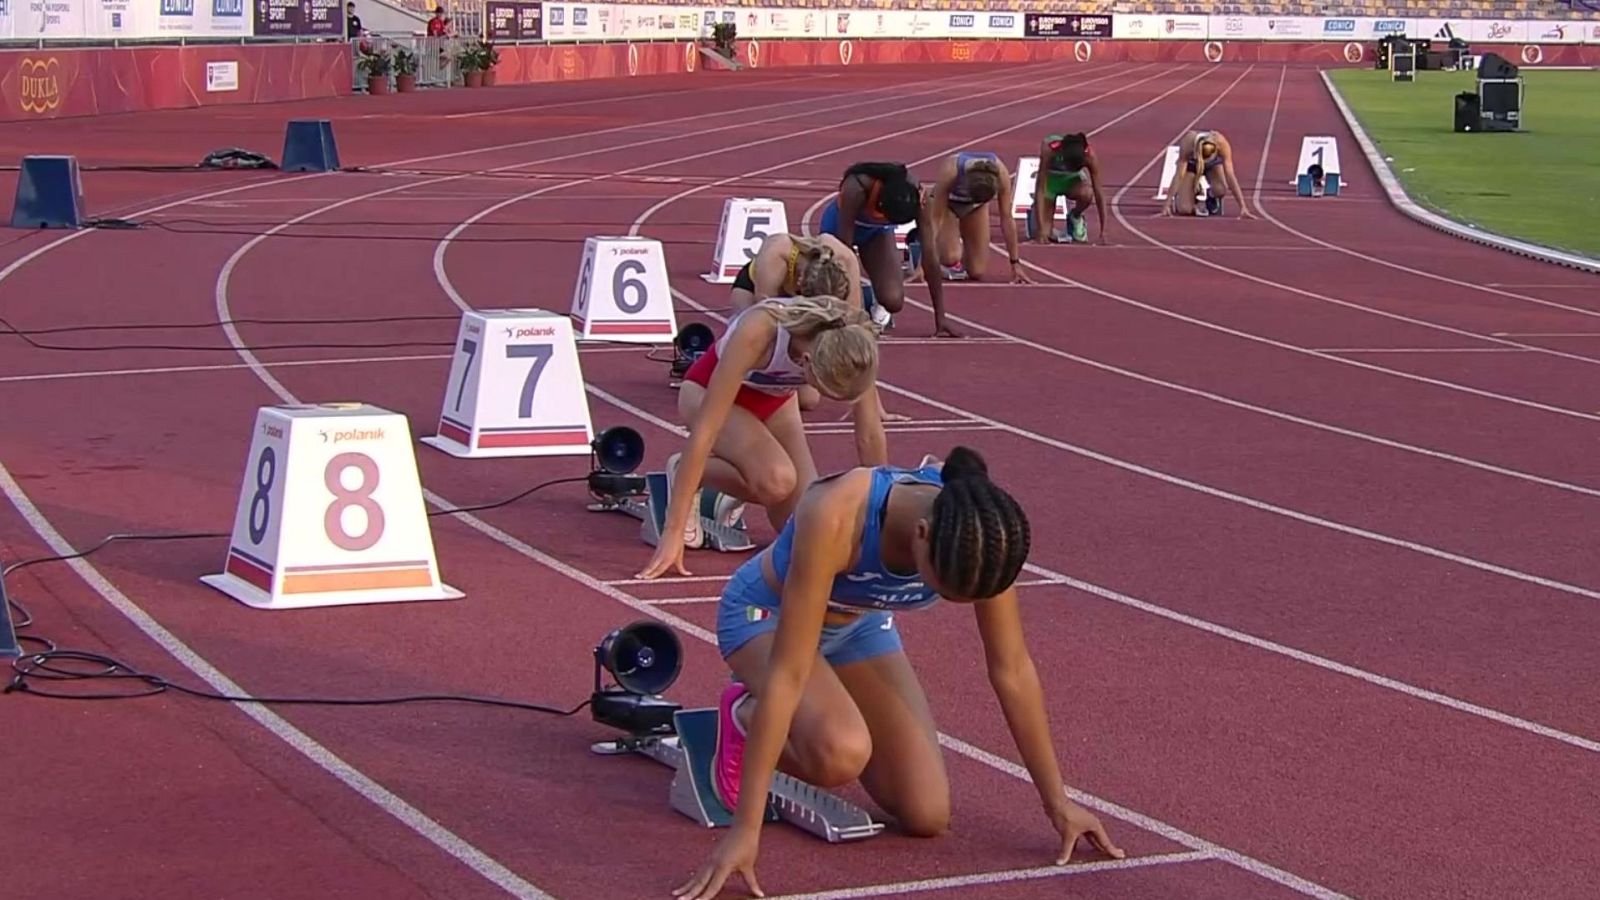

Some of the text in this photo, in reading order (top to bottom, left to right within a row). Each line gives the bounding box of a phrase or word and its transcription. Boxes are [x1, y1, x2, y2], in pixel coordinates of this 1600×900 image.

[953, 16, 973, 25] CONICA
[992, 17, 1013, 26] CONICA
[1328, 21, 1353, 30] CONICA
[1378, 22, 1403, 31] CONICA
[22, 75, 58, 99] DUKLA
[1312, 146, 1323, 168] 1
[743, 216, 770, 259] 5
[619, 247, 648, 256] polanik
[578, 257, 590, 310] 6
[612, 259, 648, 314] 6
[516, 326, 556, 339] polanik
[455, 339, 477, 412] 7
[506, 343, 554, 419] 7
[334, 428, 385, 443] polanik
[249, 446, 275, 545] 8
[324, 452, 386, 551] 8
